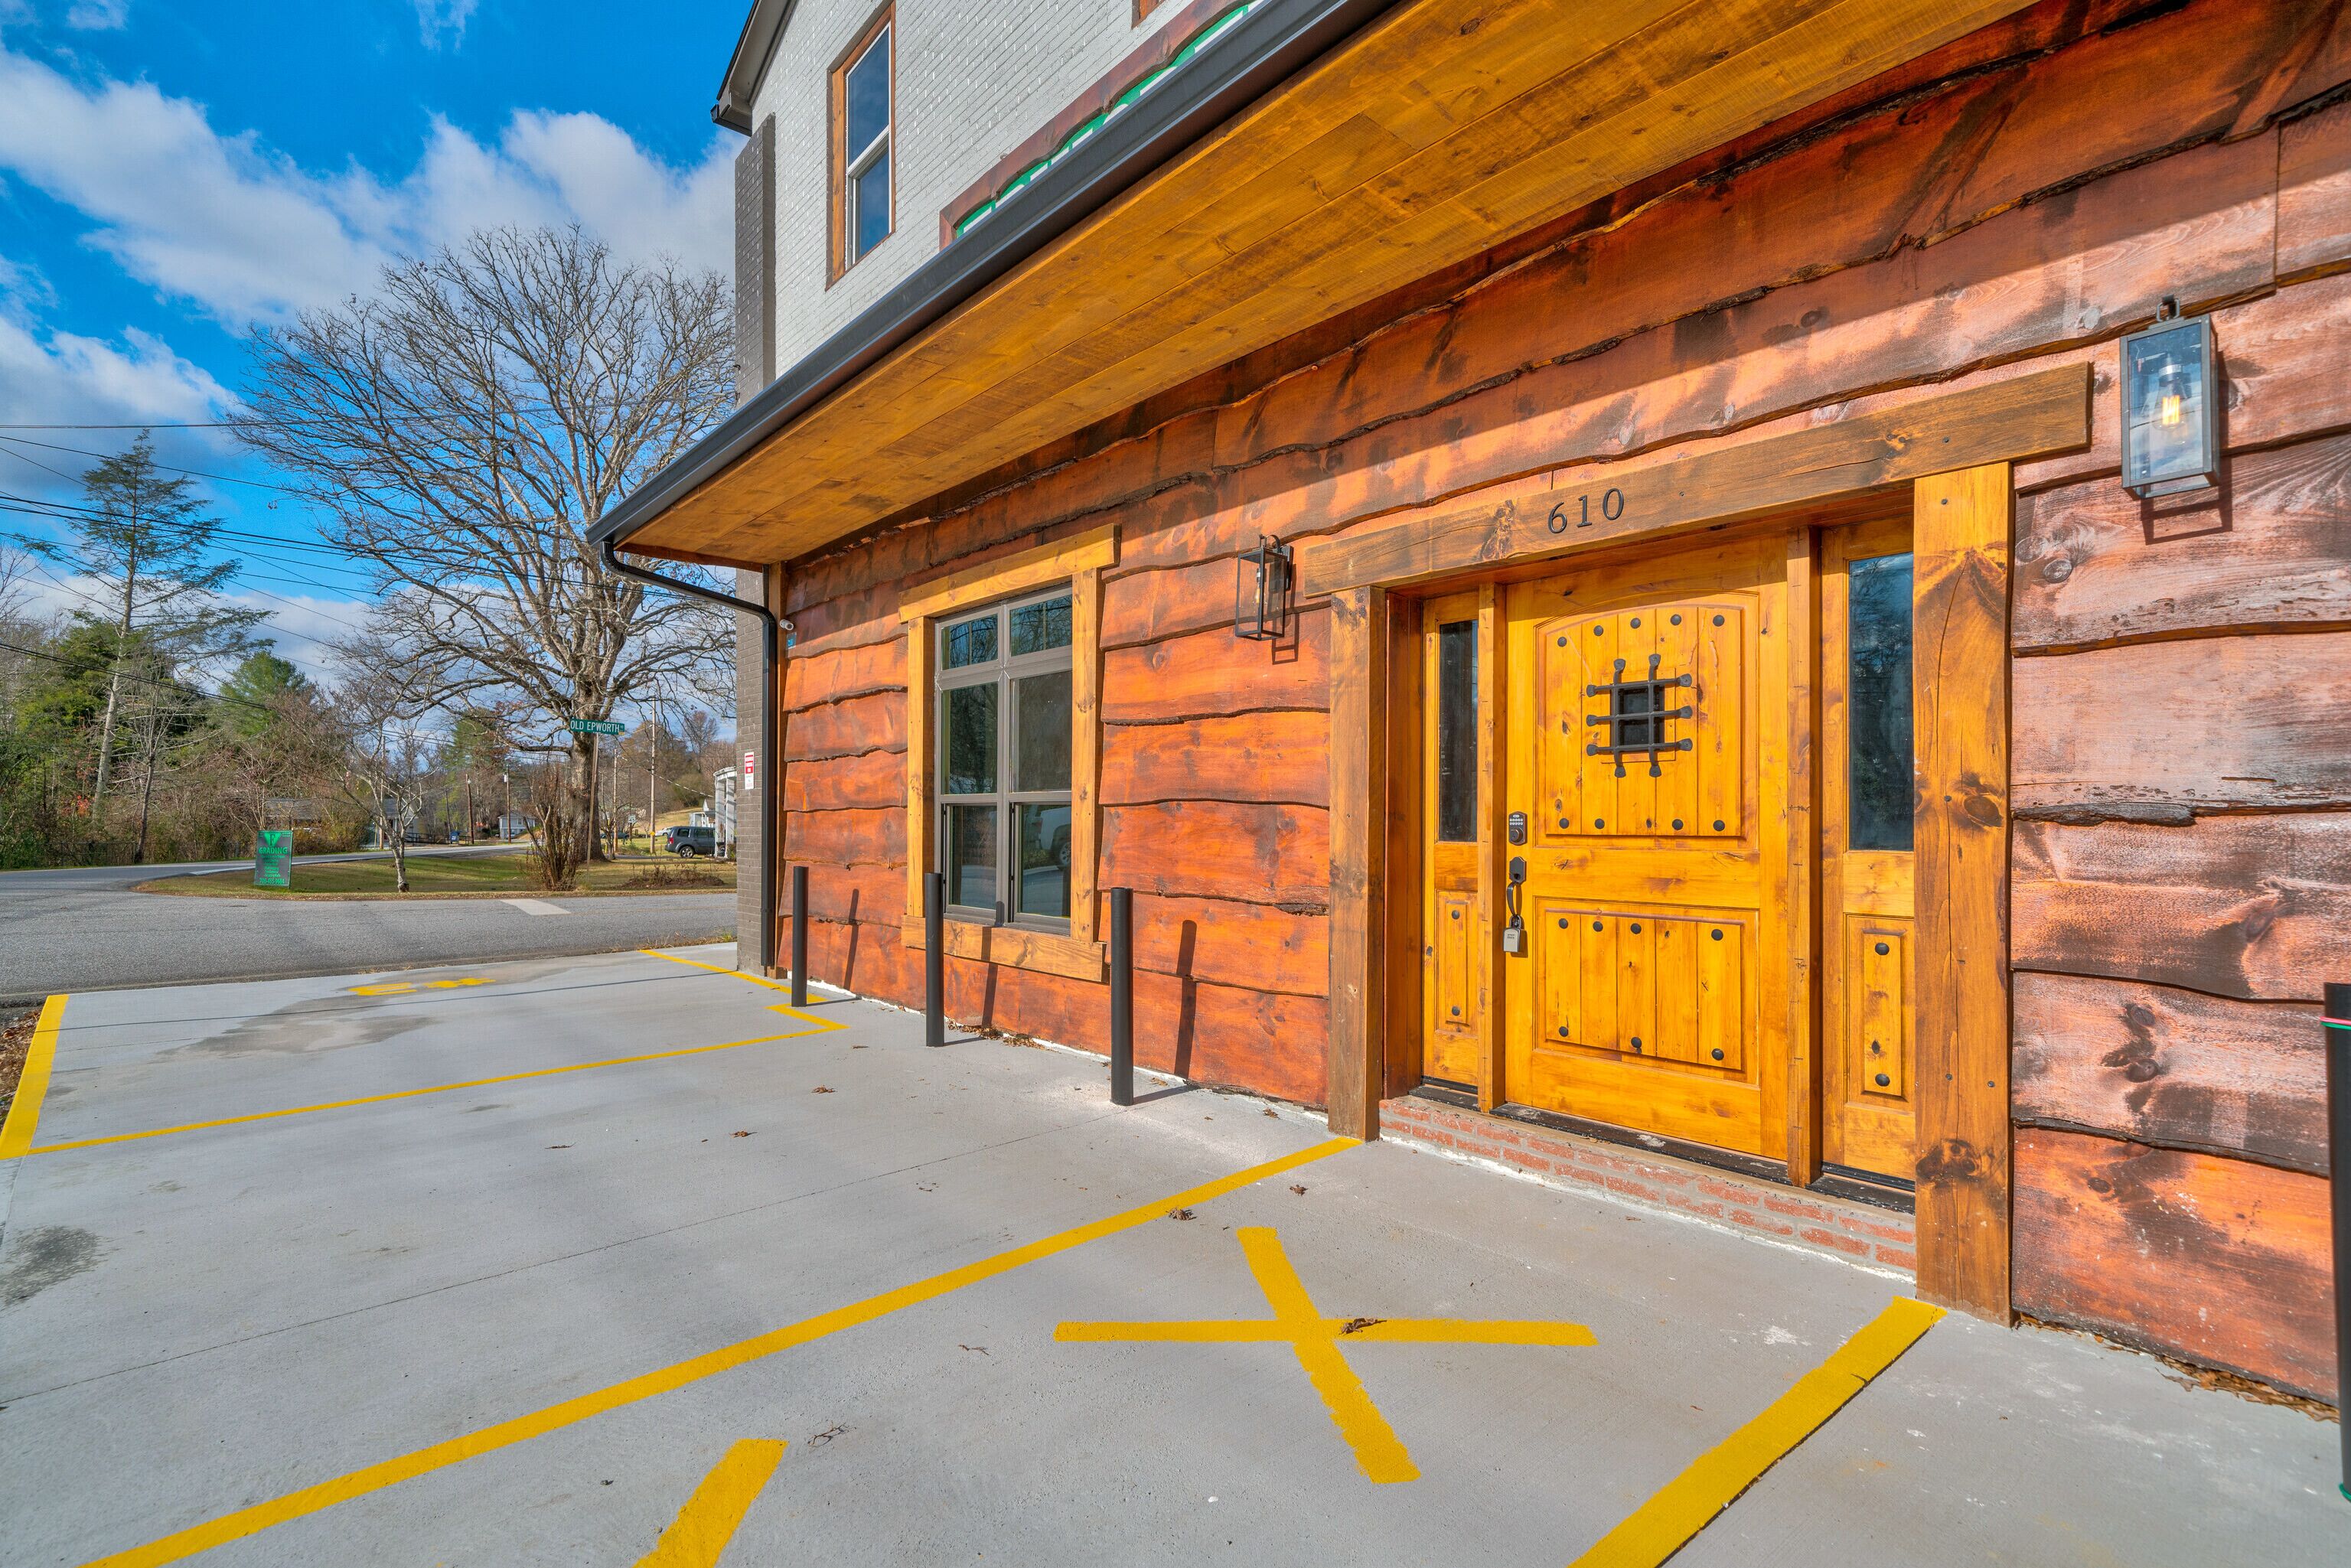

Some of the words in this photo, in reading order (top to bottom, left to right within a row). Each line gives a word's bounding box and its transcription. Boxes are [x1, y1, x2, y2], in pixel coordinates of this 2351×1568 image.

[1547, 487, 1624, 533] 610
[570, 720, 584, 730] OLD
[587, 722, 620, 732] EPWORTH
